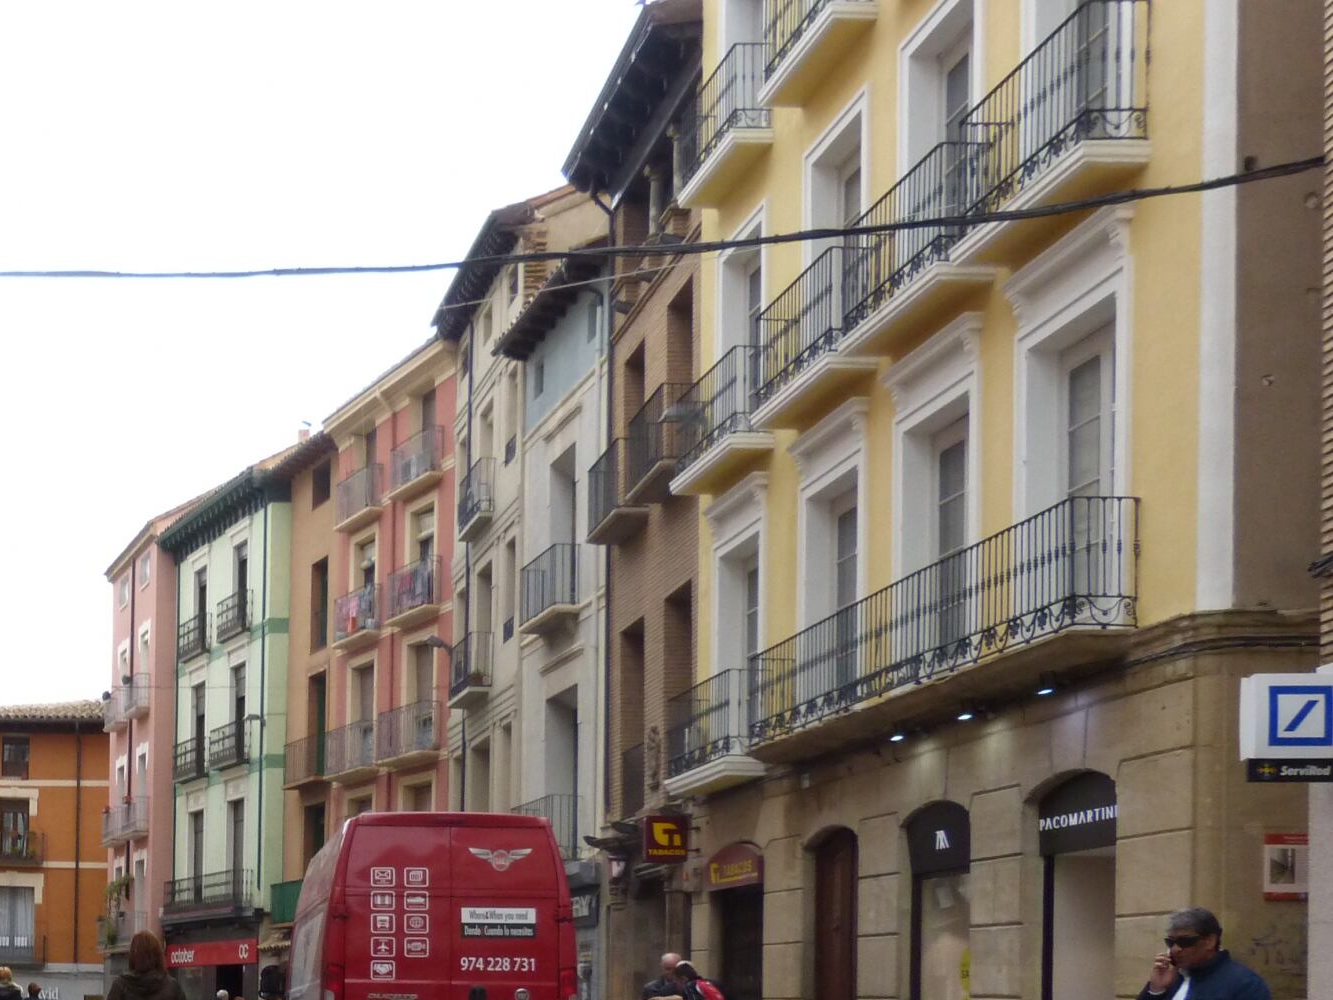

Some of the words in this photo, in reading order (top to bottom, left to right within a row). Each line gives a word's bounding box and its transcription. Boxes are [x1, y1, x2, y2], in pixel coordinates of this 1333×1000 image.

[1280, 765, 1331, 776] ServiRed
[171, 948, 195, 964] october
[460, 957, 484, 971] 974
[487, 957, 510, 971] 228
[514, 958, 536, 971] 731
